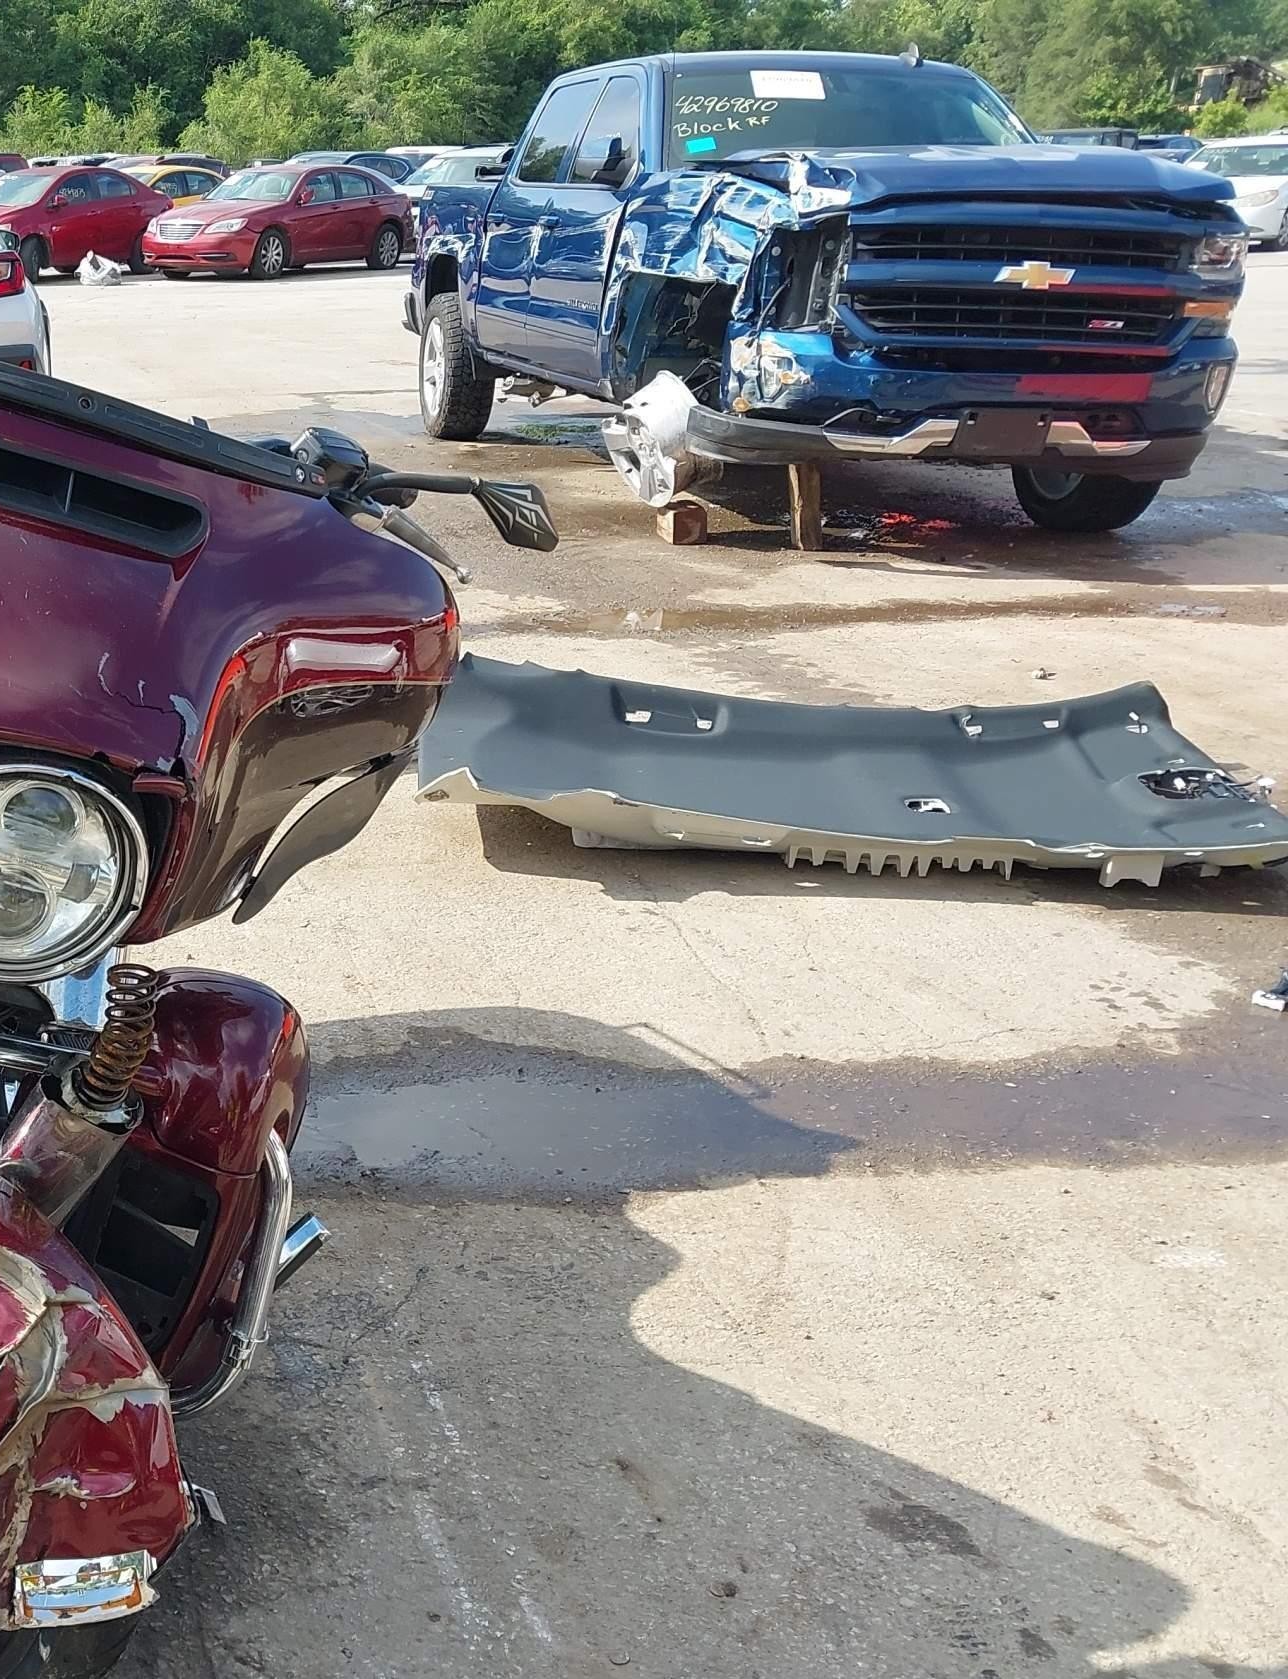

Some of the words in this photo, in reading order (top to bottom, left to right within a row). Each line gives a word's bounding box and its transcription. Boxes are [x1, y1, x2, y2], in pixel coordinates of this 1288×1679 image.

[675, 96, 778, 114] 42969810
[674, 118, 743, 137] Block
[746, 116, 771, 127] RF
